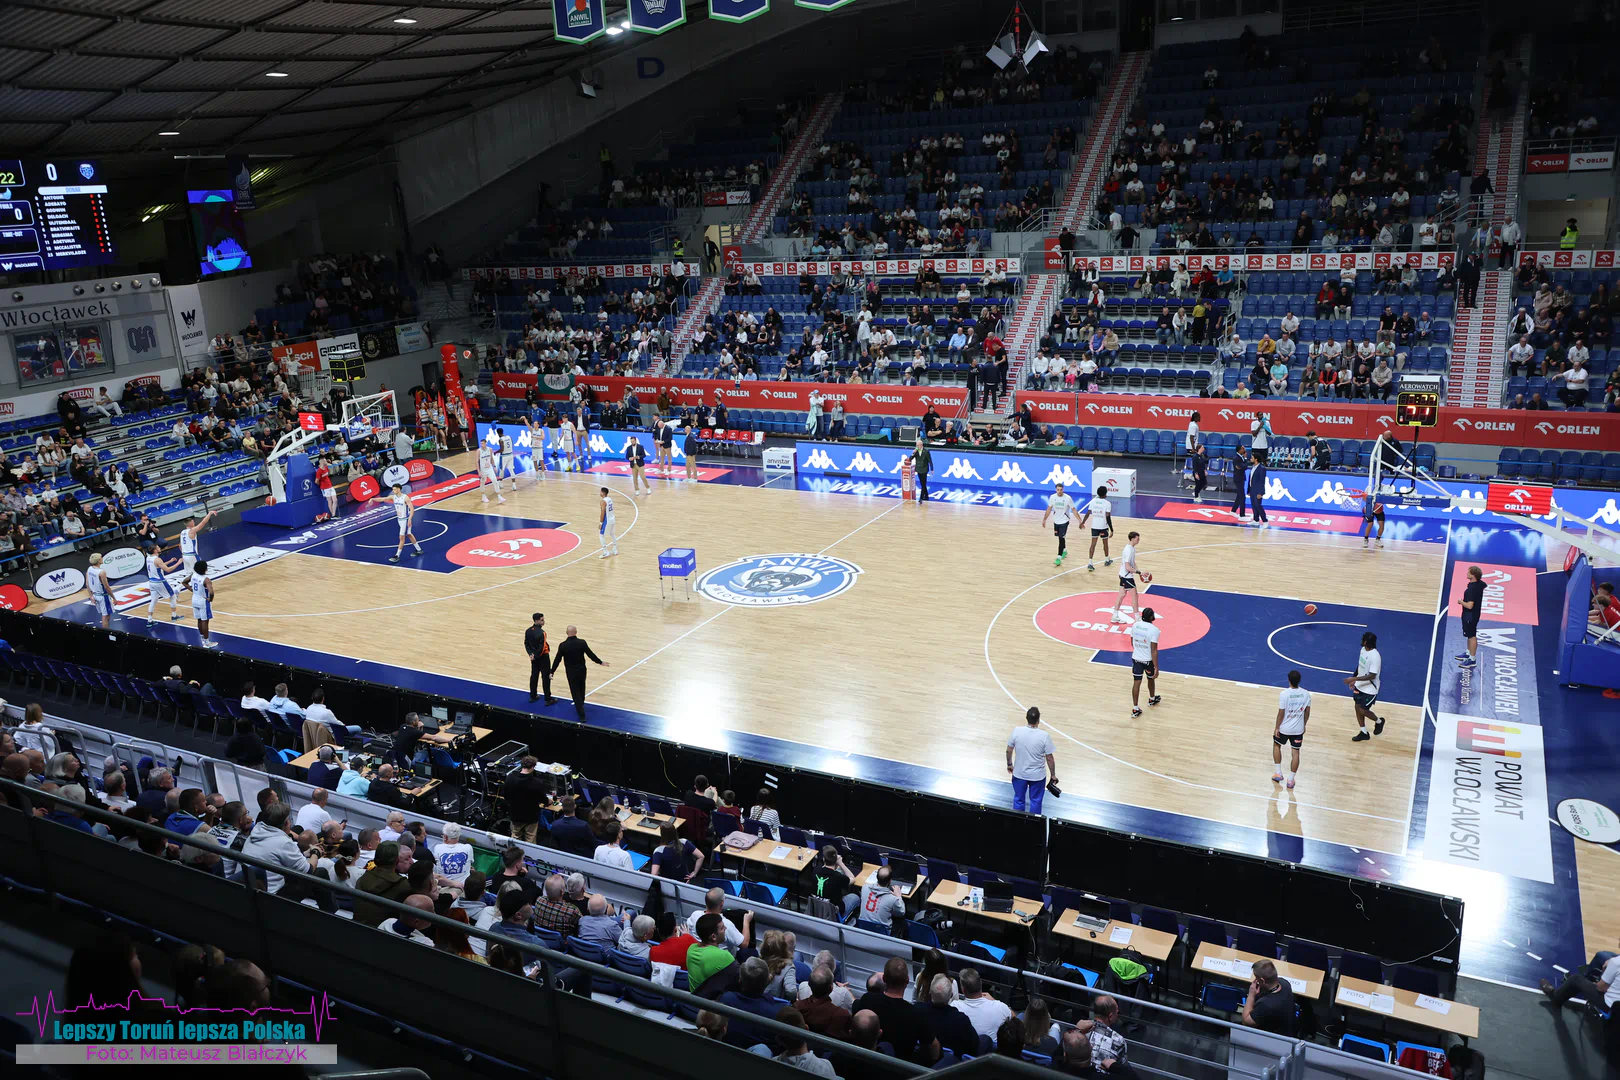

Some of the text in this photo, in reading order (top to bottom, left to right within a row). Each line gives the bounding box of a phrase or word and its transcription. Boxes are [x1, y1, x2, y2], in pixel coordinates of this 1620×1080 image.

[570, 14, 589, 22] ANWIL
[46, 163, 57, 181] 0
[14, 208, 23, 220] 0
[0, 301, 111, 328] Włocławek
[876, 395, 902, 403] ORLEN
[1039, 403, 1068, 411] ORLEN
[1102, 406, 1133, 414] ORLEN
[1317, 414, 1353, 424] ORLEN
[1475, 420, 1515, 431] ORLEN
[1557, 424, 1600, 435] ORLEN
[469, 548, 526, 560] ORLEN
[758, 557, 849, 575] ANWIL
[193, 583, 199, 591] 8
[1494, 655, 1519, 715] WŁOCŁAWEK
[1494, 761, 1523, 820] POWIAT
[1449, 757, 1481, 861] WŁOCŁAWSKI
[1425, 998, 1444, 1007] FOTO
